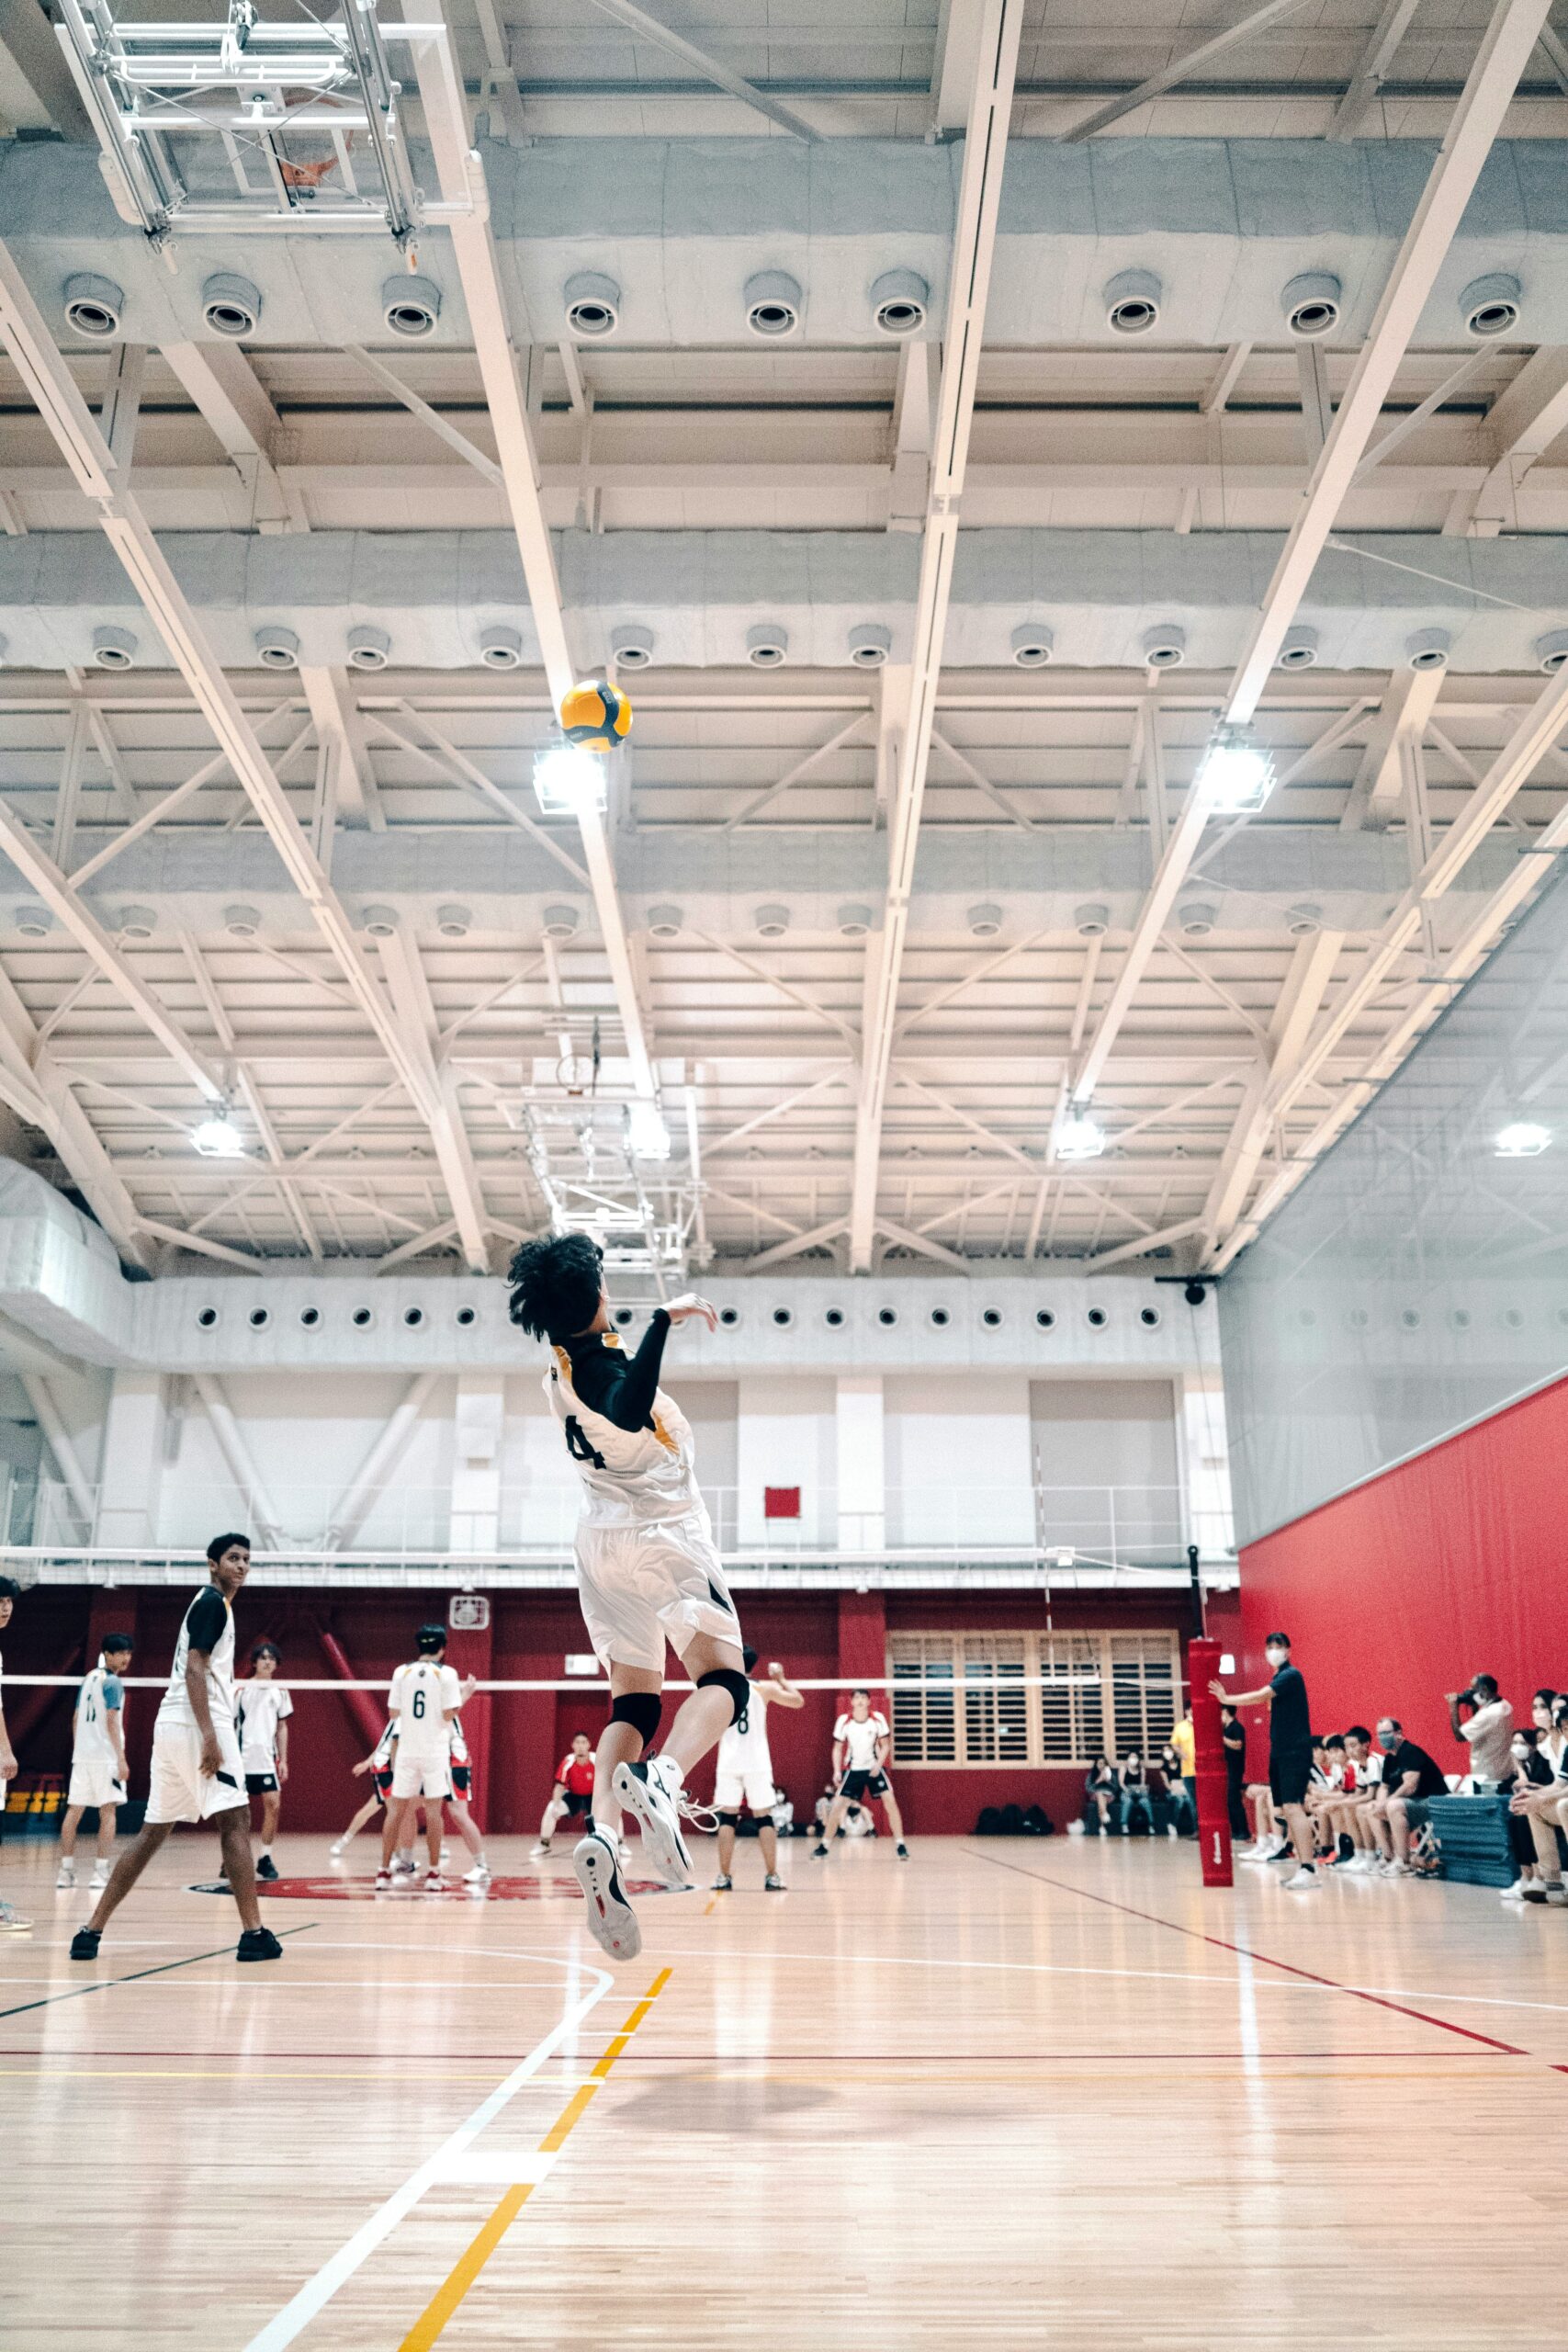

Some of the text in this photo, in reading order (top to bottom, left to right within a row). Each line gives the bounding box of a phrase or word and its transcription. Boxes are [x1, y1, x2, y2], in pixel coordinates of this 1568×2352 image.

[565, 1415, 607, 1470] 4
[412, 1690, 425, 1719] 6
[738, 1707, 749, 1735] 8
